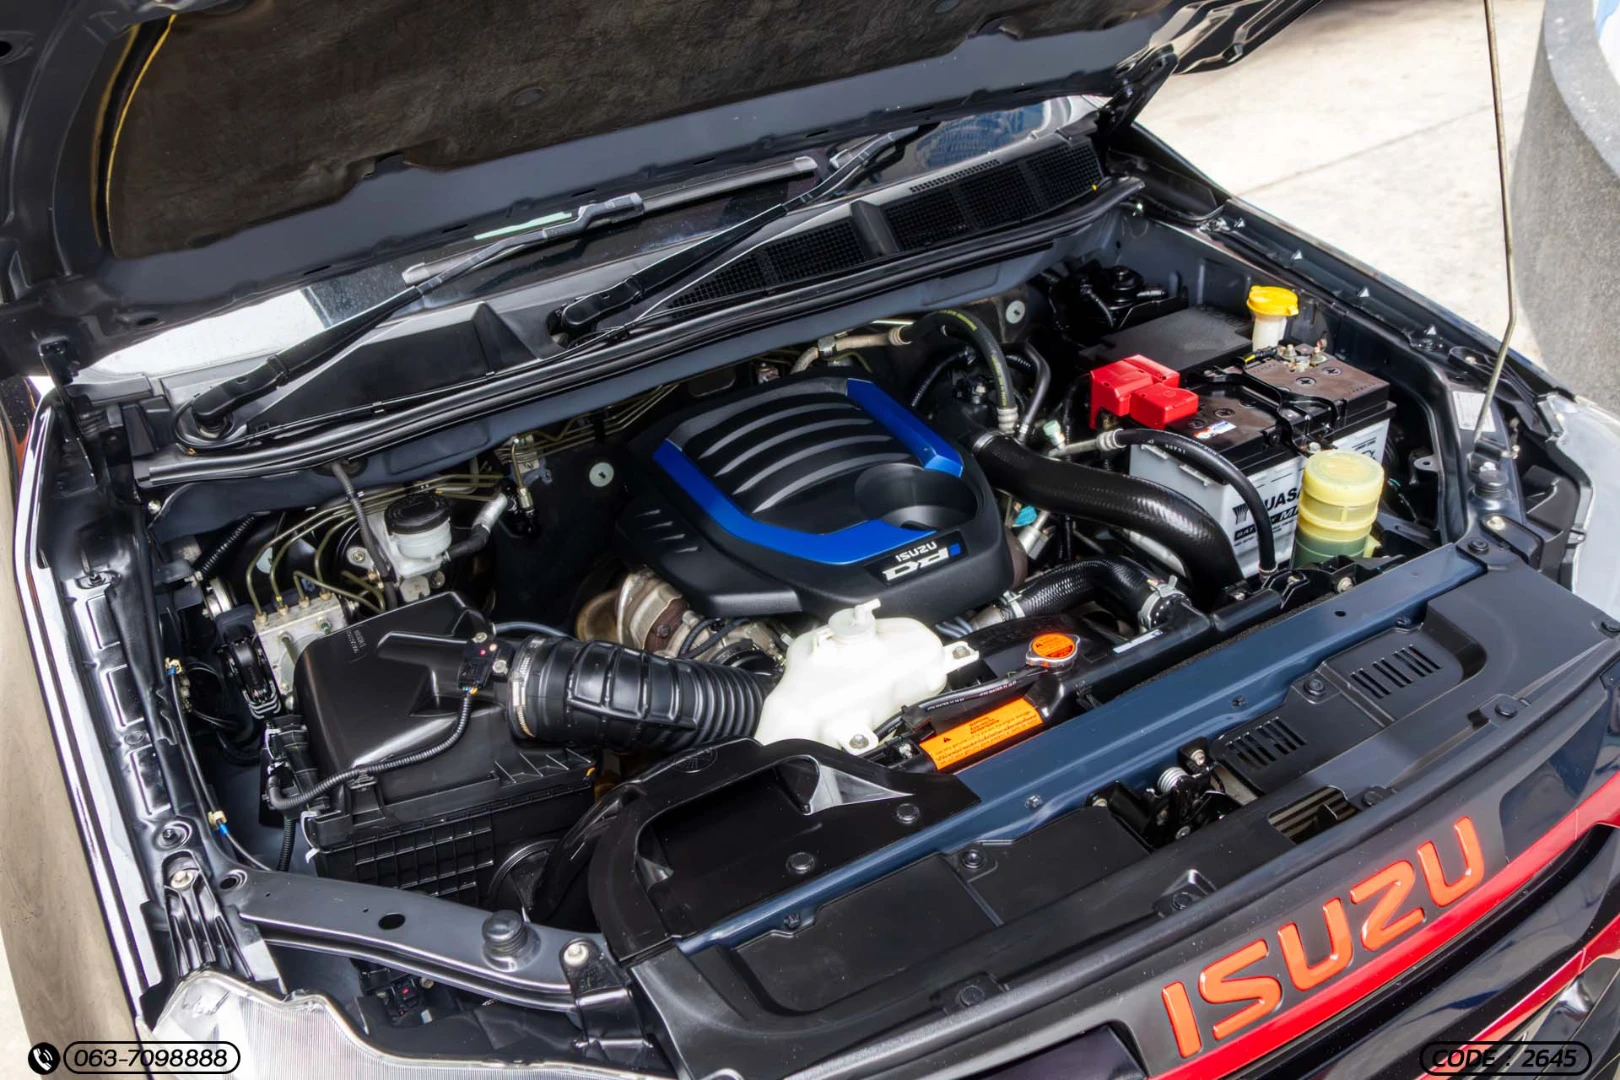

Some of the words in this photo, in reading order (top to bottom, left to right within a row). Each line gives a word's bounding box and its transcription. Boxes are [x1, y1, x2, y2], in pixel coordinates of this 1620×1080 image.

[1264, 487, 1301, 511] UAS
[895, 541, 937, 562] ISUZU
[1162, 816, 1485, 1059] ISUZU
